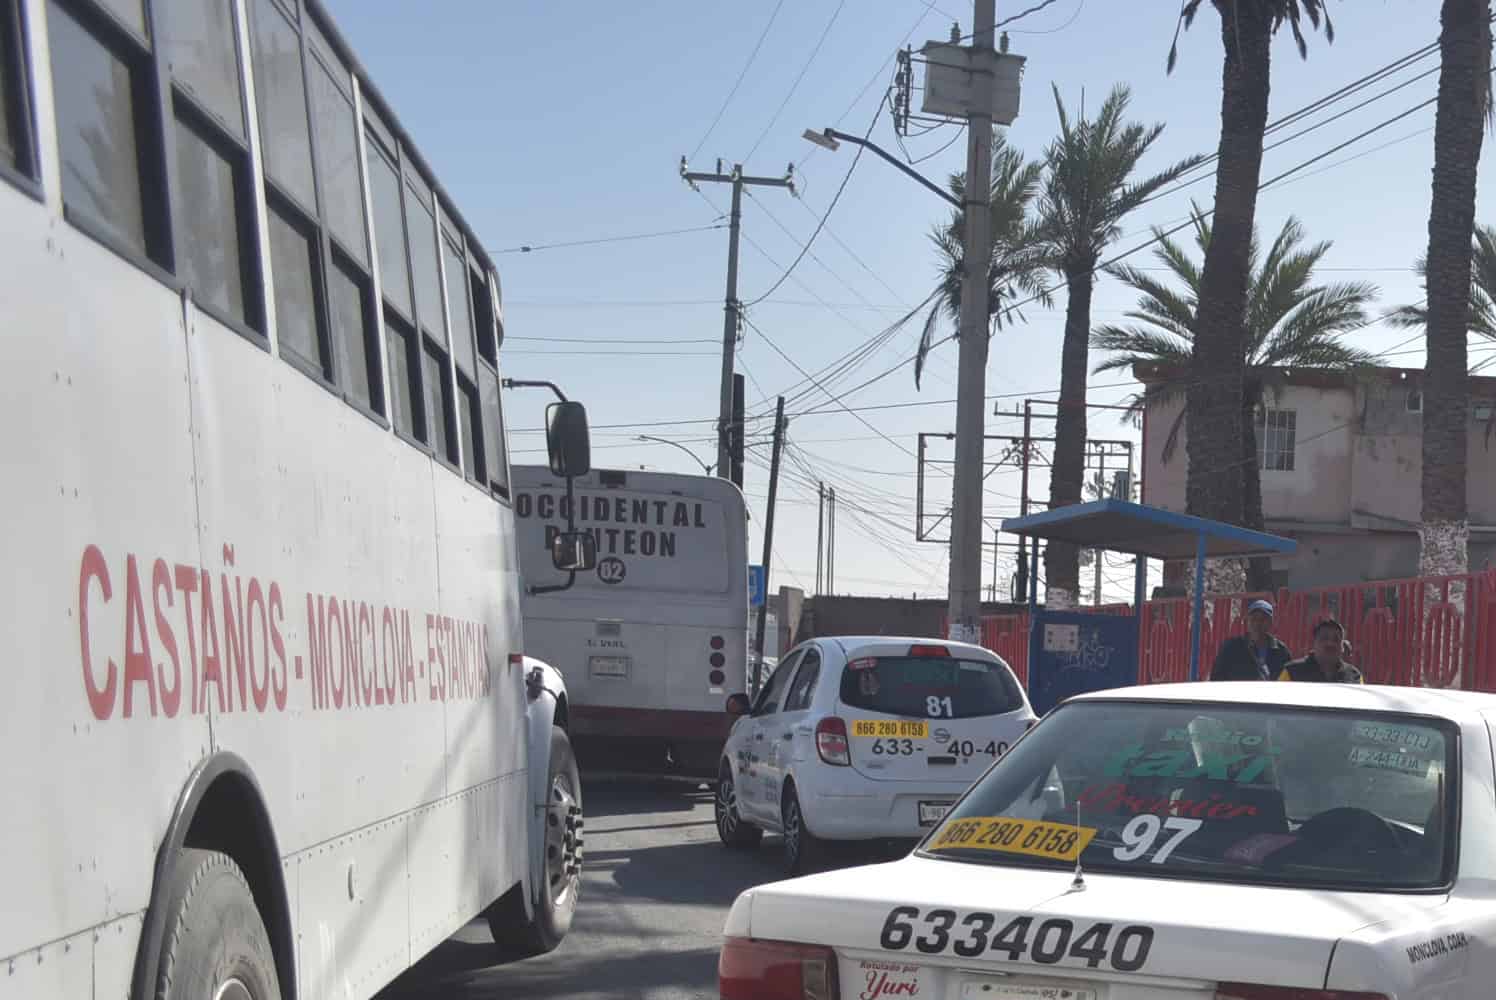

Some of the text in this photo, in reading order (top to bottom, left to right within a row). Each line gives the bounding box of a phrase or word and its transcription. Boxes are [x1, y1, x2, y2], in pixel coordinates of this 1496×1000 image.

[516, 493, 706, 528] OCCIDENTAL
[545, 524, 677, 557] PNTEON
[80, 542, 288, 720] CASTAÑOS
[307, 592, 416, 710] MONCLOVA
[925, 696, 953, 717] 81
[976, 822, 1024, 846] 280
[1022, 826, 1079, 854] 6158
[1113, 814, 1203, 864] 97
[880, 906, 1155, 971] 6334040
[860, 971, 920, 1000] Yuri
